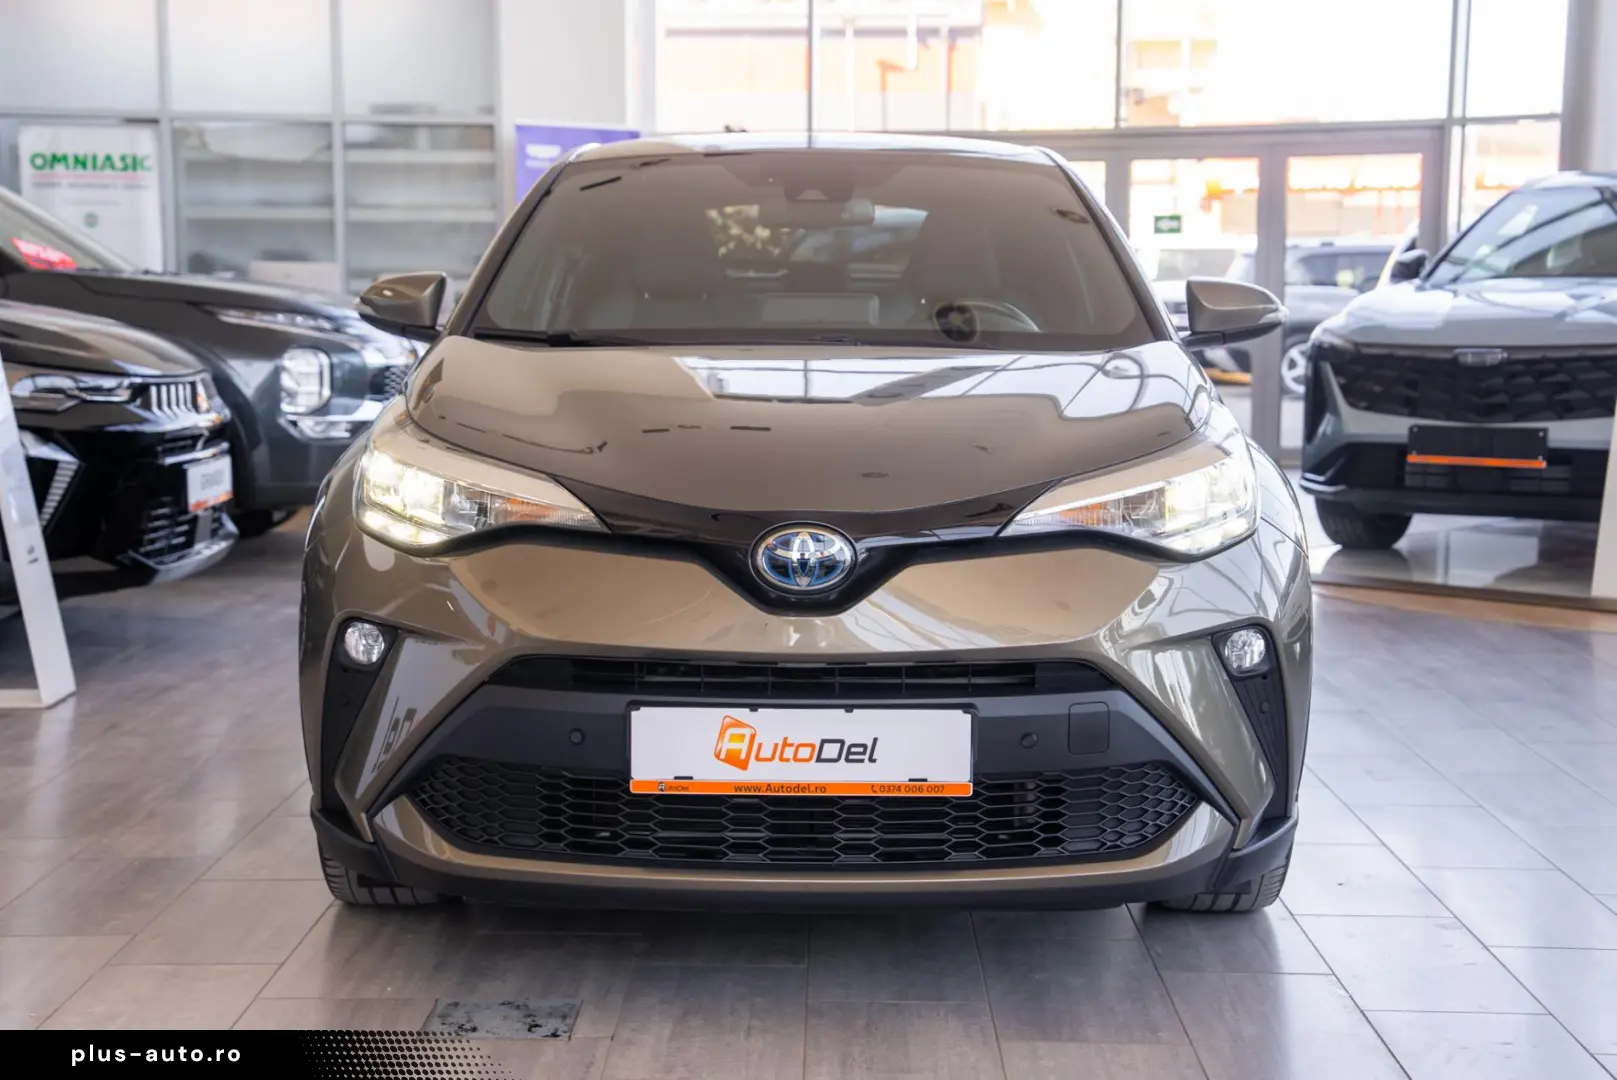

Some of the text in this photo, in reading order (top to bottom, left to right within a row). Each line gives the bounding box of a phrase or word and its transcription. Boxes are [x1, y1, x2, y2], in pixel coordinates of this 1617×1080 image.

[715, 722, 878, 766] AutoDel
[734, 783, 827, 794] www.Autodel.ro
[879, 785, 945, 794] 0374 006 007
